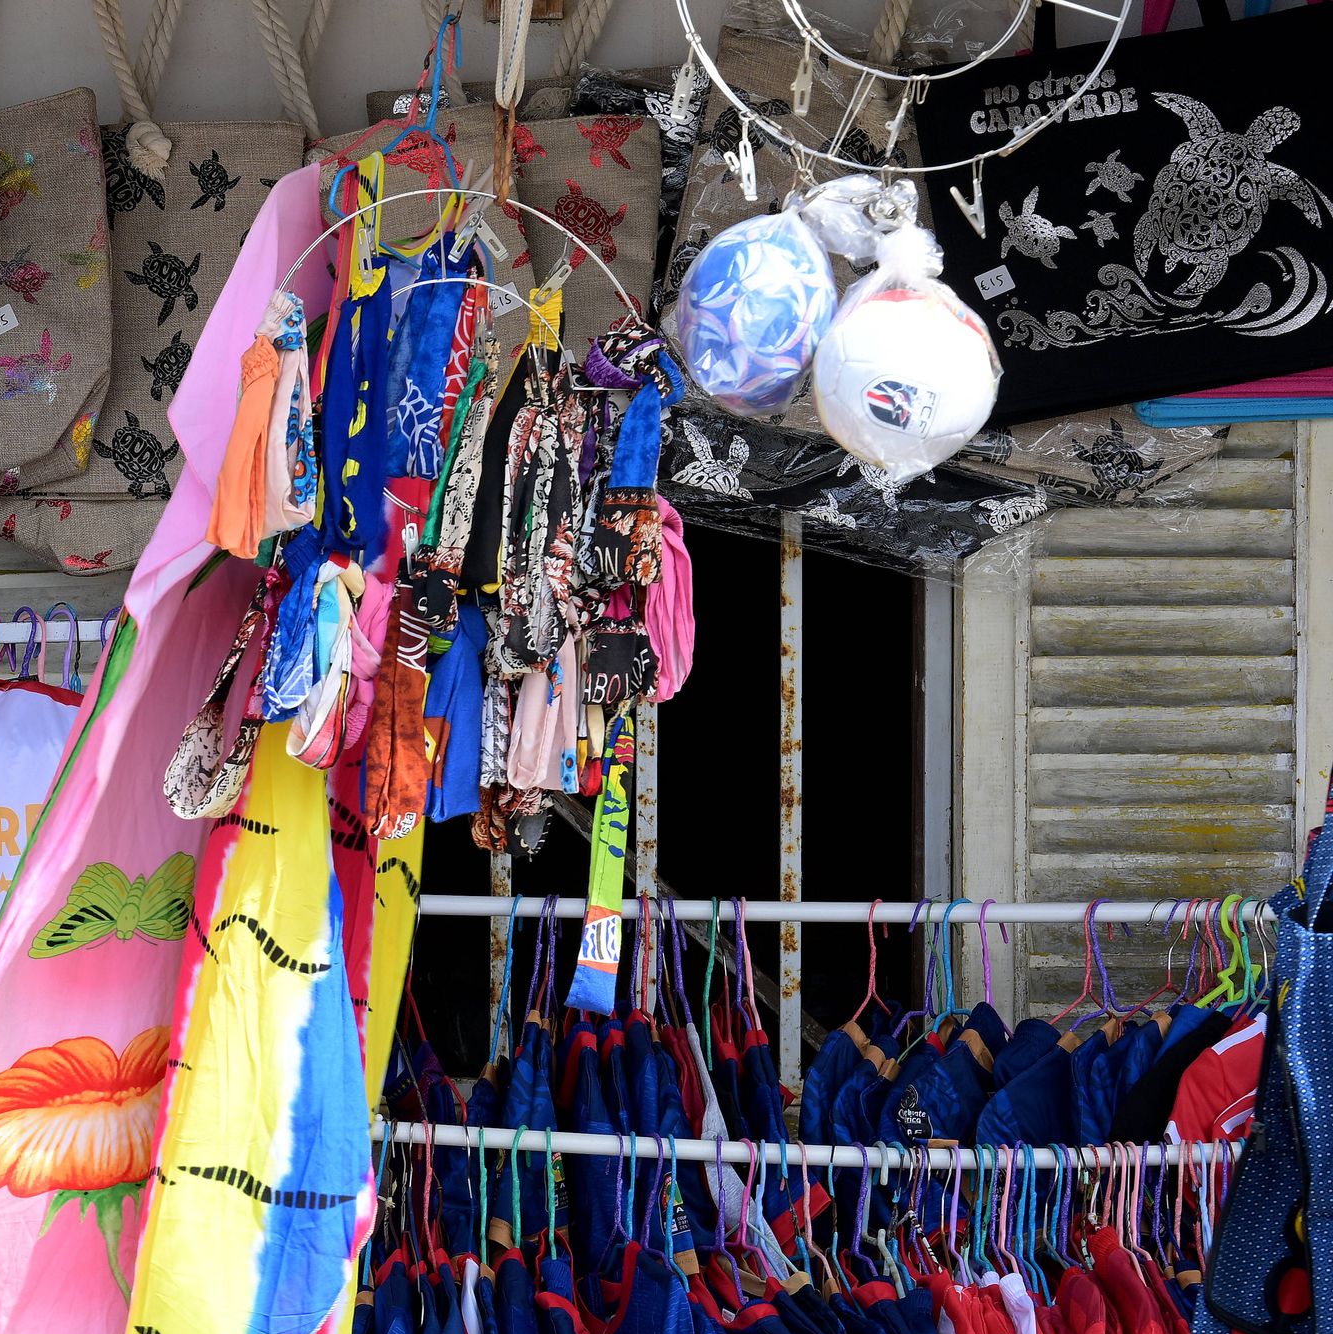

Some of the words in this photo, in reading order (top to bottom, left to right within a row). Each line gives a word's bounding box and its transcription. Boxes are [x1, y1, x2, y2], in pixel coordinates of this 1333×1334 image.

[984, 84, 1019, 106] no
[1028, 69, 1117, 101] stress
[970, 103, 1041, 134] CABO
[1047, 87, 1138, 124] VERDE
[980, 274, 1004, 291] €15
